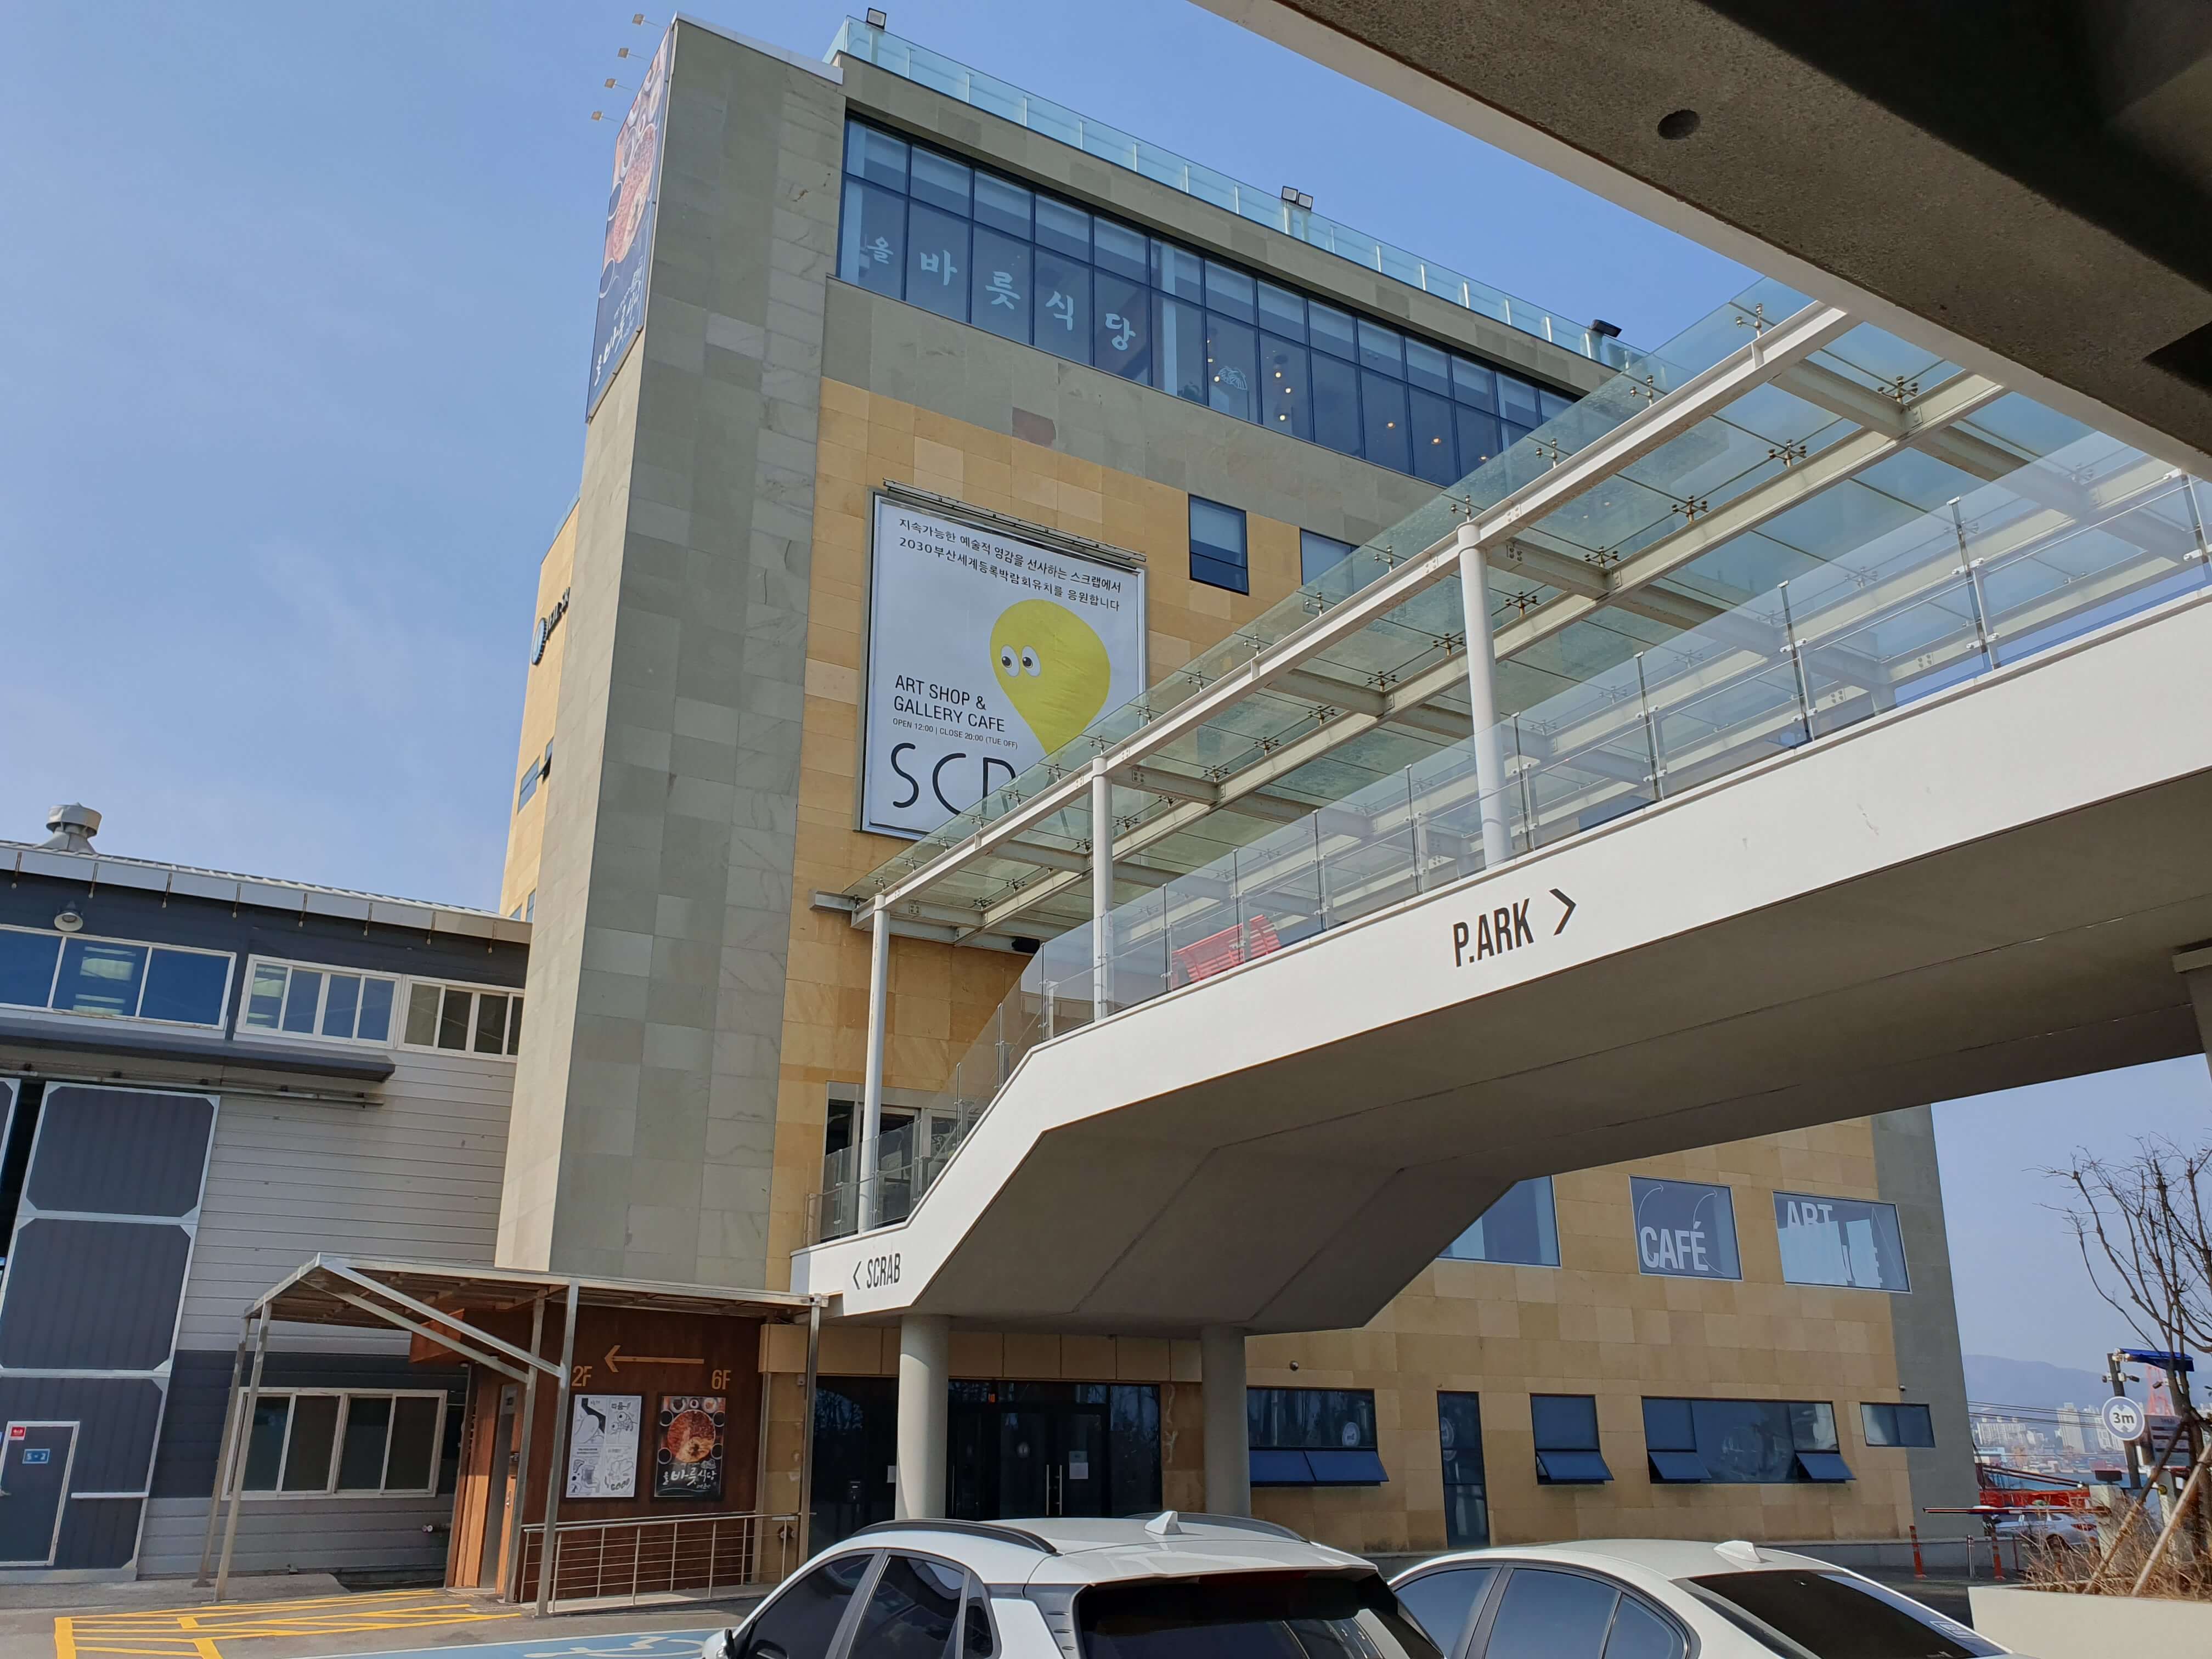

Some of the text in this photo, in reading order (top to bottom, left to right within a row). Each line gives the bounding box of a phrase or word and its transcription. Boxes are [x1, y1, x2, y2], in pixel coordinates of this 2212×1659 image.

[900, 518, 1121, 593] 지속가능한 예술적 영감을 선사하는 스크랩에서
[1068, 589, 1120, 612] 응원합니다
[895, 675, 986, 710] ART SHOP &
[893, 718, 912, 729] OPEN
[915, 723, 933, 733] 12:00
[940, 727, 963, 738] CLOSE
[964, 732, 984, 742] 20:00
[894, 696, 1005, 732] GALLERY CAFE
[1453, 898, 1534, 968] P.ARK
[1640, 1221, 1709, 1271] CAFÉ
[867, 1252, 901, 1289] SCRAB
[572, 1365, 592, 1387] 2F
[711, 1369, 731, 1390] 6F
[2113, 1412, 2135, 1424] 3m
